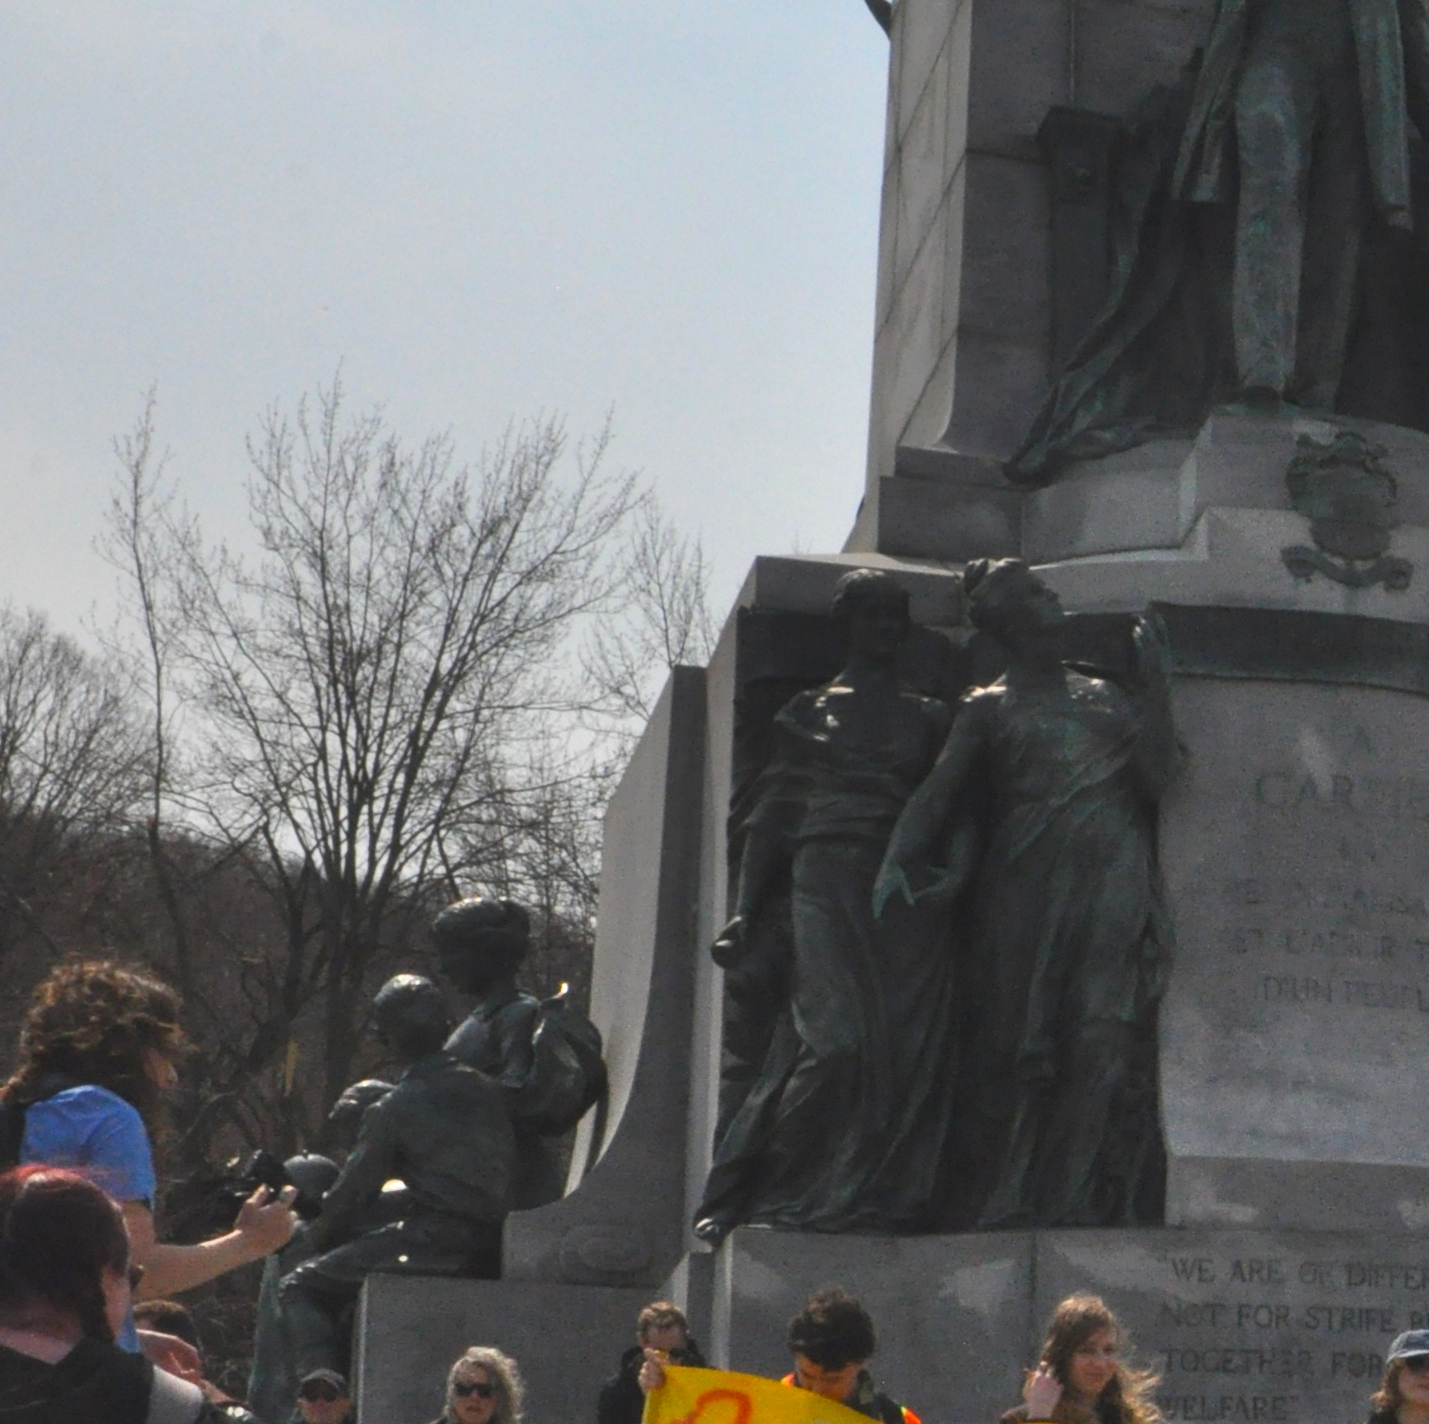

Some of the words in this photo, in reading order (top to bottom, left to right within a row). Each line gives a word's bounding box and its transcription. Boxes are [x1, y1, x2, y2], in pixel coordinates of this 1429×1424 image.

[1230, 1258, 1286, 1285] ARE
[1161, 1301, 1226, 1330] NOT
[1237, 1303, 1290, 1331] FOR
[1304, 1306, 1396, 1335] STRIFE
[1161, 1346, 1314, 1379] TOGETHER
